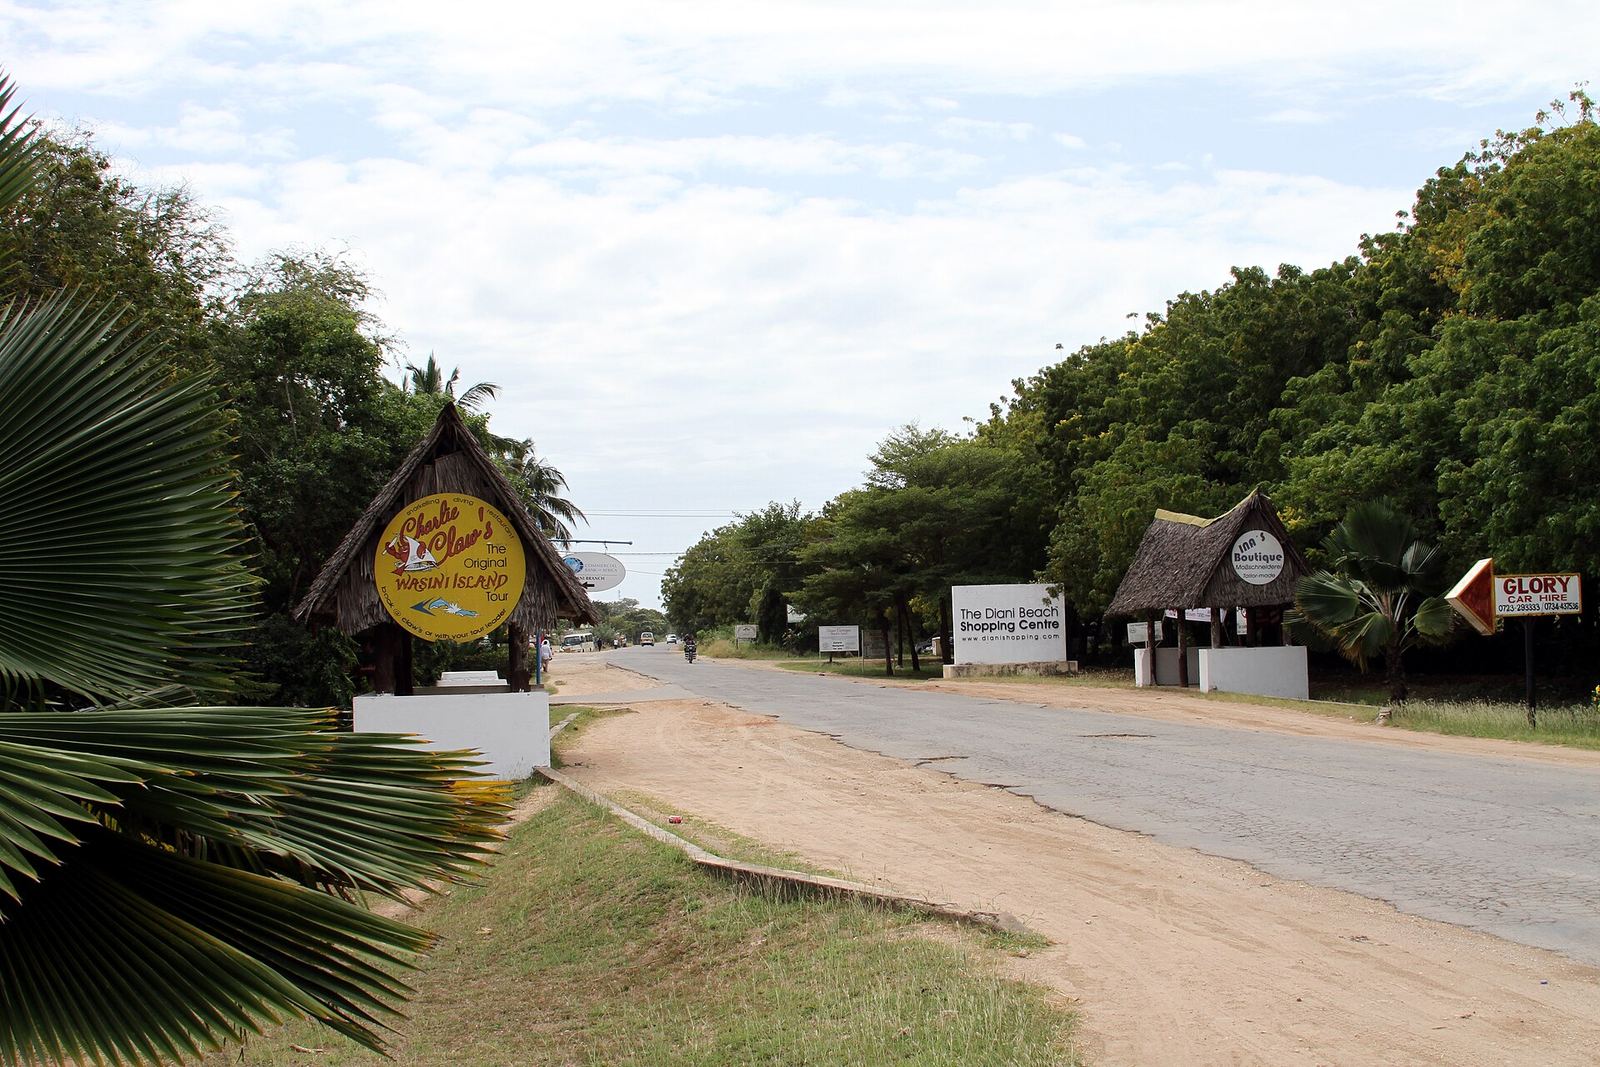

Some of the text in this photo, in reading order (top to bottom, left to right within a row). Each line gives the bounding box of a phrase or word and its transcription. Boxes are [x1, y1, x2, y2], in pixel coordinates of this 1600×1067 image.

[399, 499, 460, 546] Charlie
[406, 496, 514, 539] snorkelling diving restaurant
[428, 506, 493, 567] Claw's
[486, 543, 507, 554] The
[463, 557, 507, 571] Original
[1234, 552, 1283, 564] Boutique
[395, 571, 508, 592] WASINI ISLAND
[1503, 577, 1570, 594] GLORY
[486, 591, 509, 602] Tour
[1508, 594, 1567, 604] CAR HIRE
[381, 585, 394, 608] book
[401, 617, 423, 634] claw's
[434, 632, 450, 640] with
[451, 632, 469, 640] your
[470, 626, 485, 636] tour
[485, 608, 507, 629] leader
[960, 606, 1059, 620] The Diani Beach
[960, 619, 1060, 633] Shopping Centre
